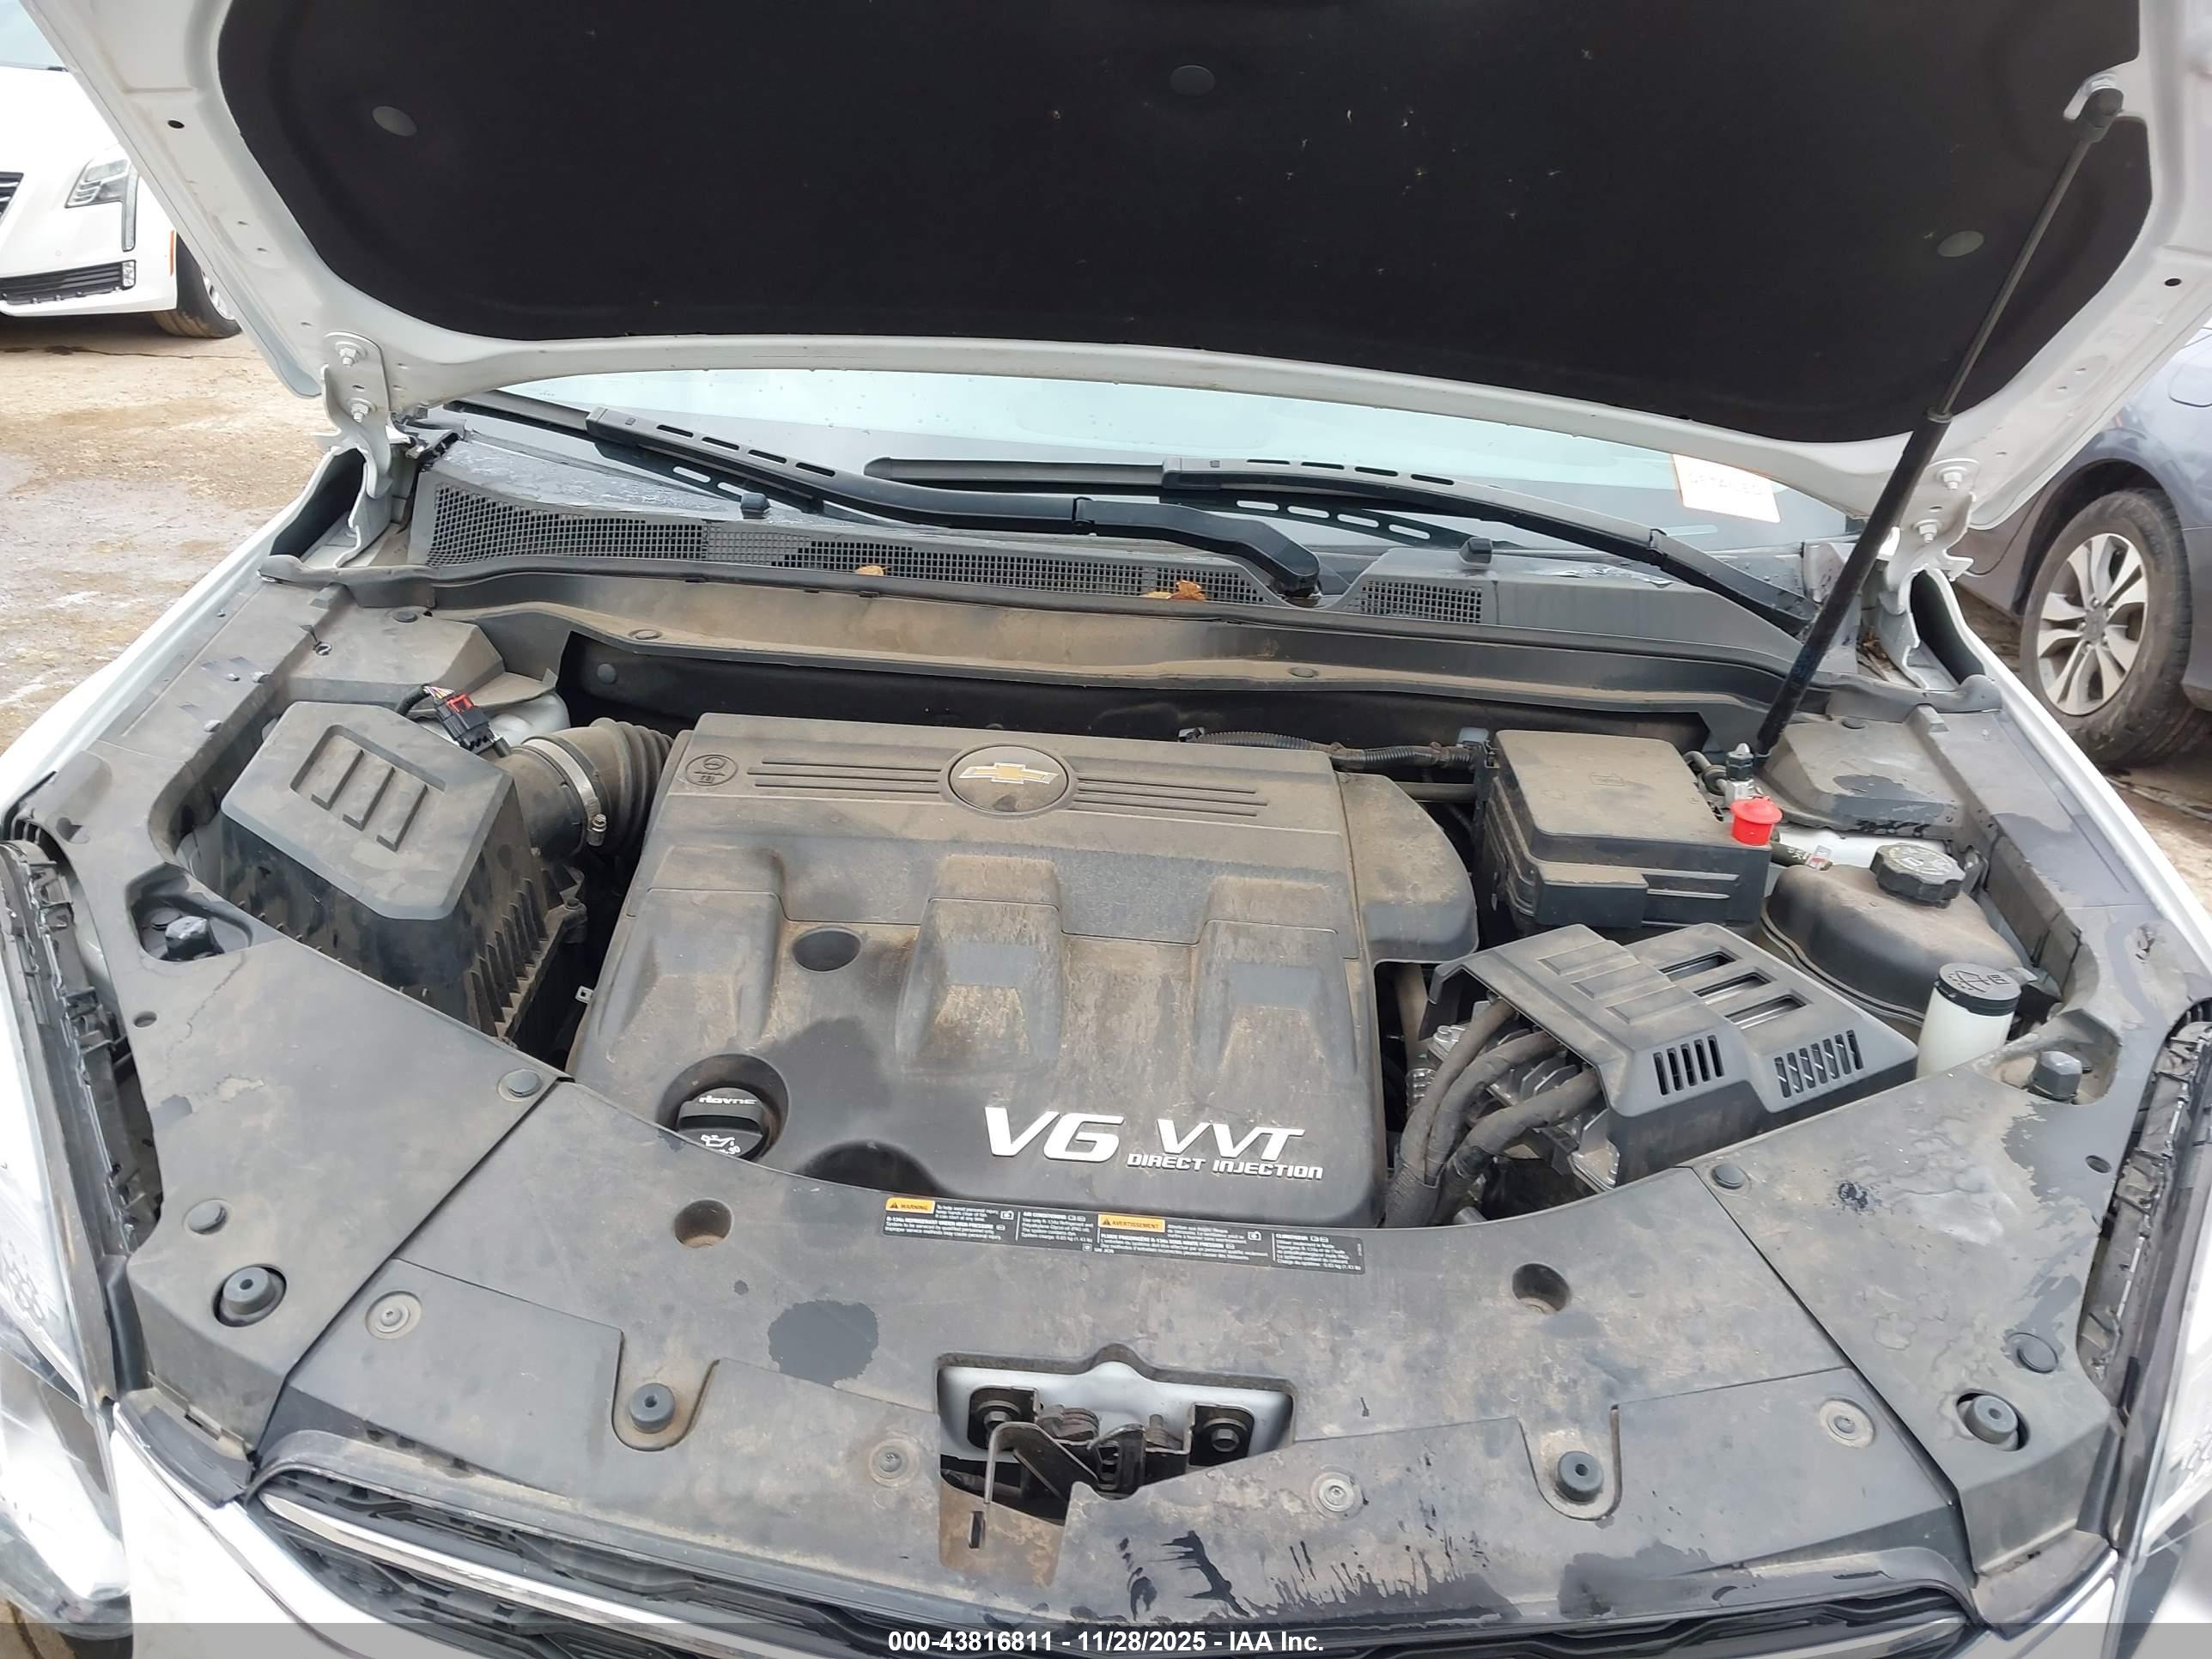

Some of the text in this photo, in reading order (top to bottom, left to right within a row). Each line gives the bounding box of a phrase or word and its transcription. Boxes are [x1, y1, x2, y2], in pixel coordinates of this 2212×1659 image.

[985, 1107, 1305, 1163] V6 VVT
[1127, 1153, 1323, 1180] DIRECT INJECTION
[1112, 1218, 1159, 1228] AVERTISSEMENT
